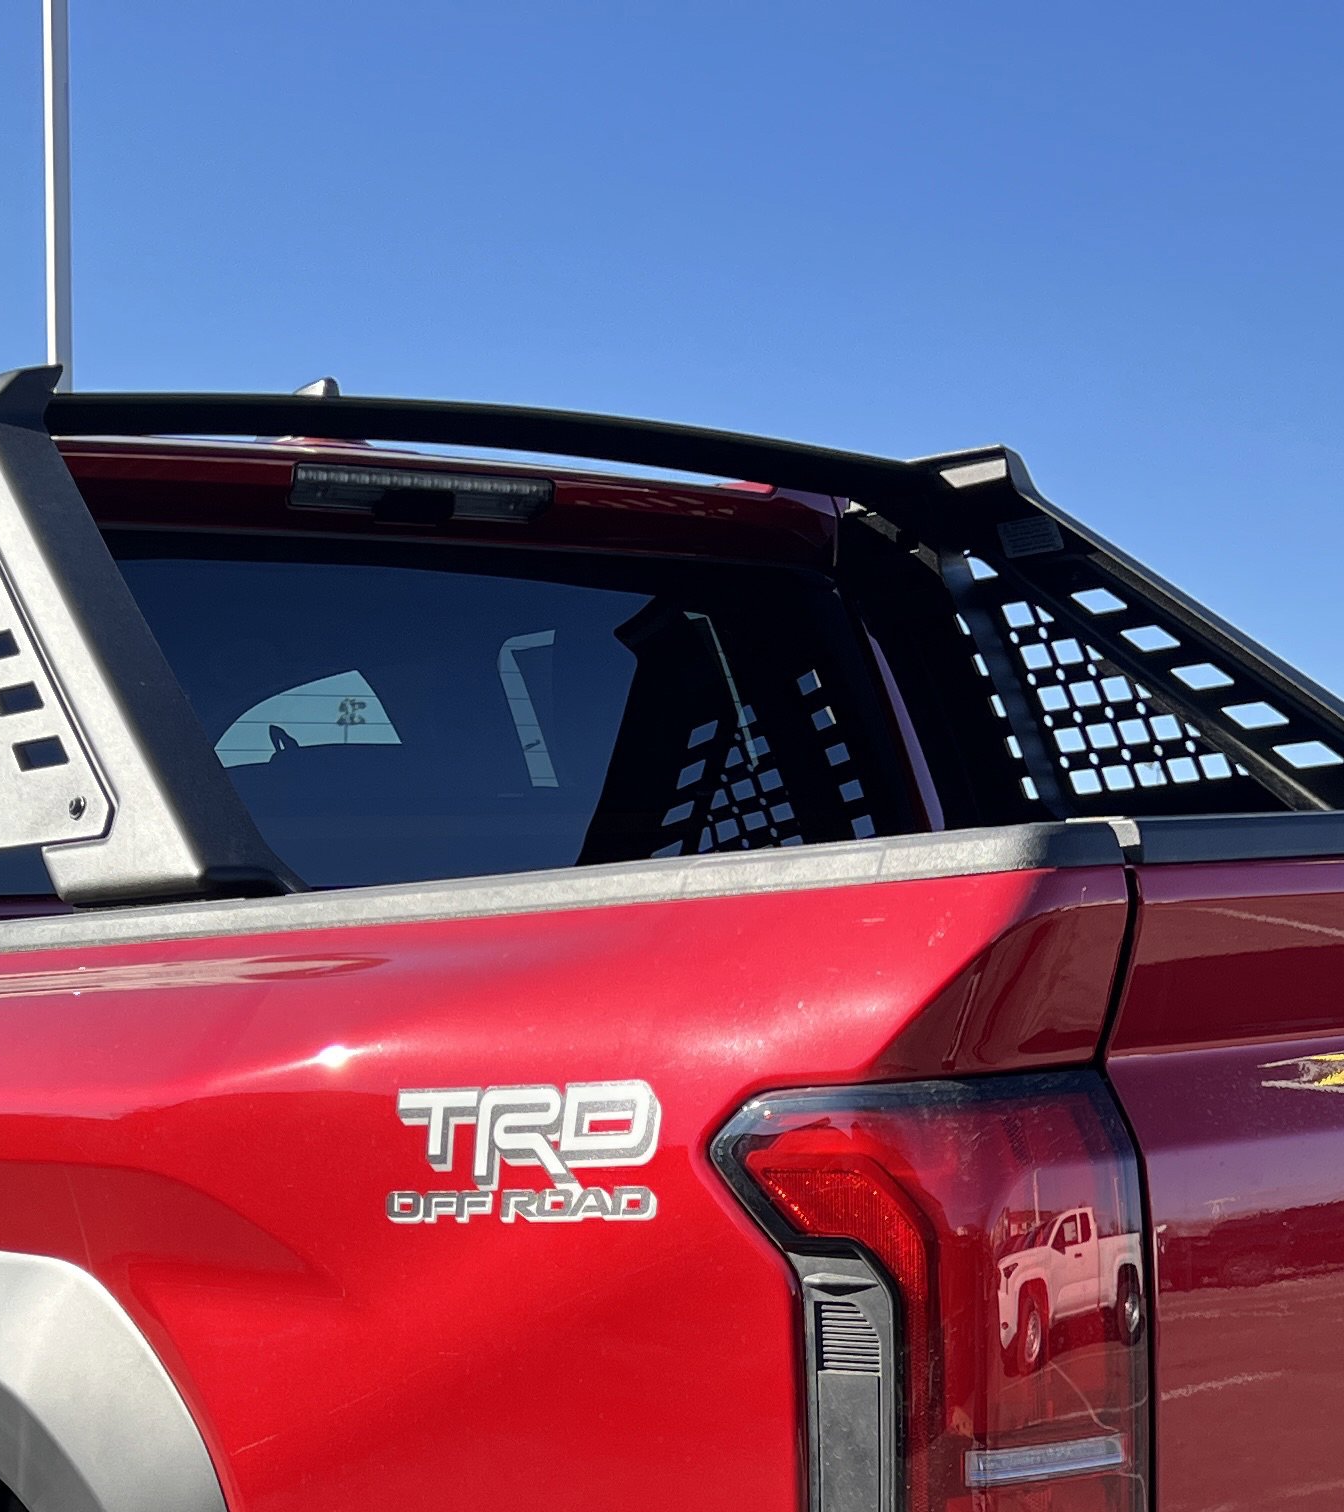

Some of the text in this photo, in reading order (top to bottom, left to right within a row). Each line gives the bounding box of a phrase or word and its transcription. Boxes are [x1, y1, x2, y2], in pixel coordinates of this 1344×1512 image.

[396, 1079, 662, 1193] TRD
[386, 1185, 657, 1224] OFF ROAD
